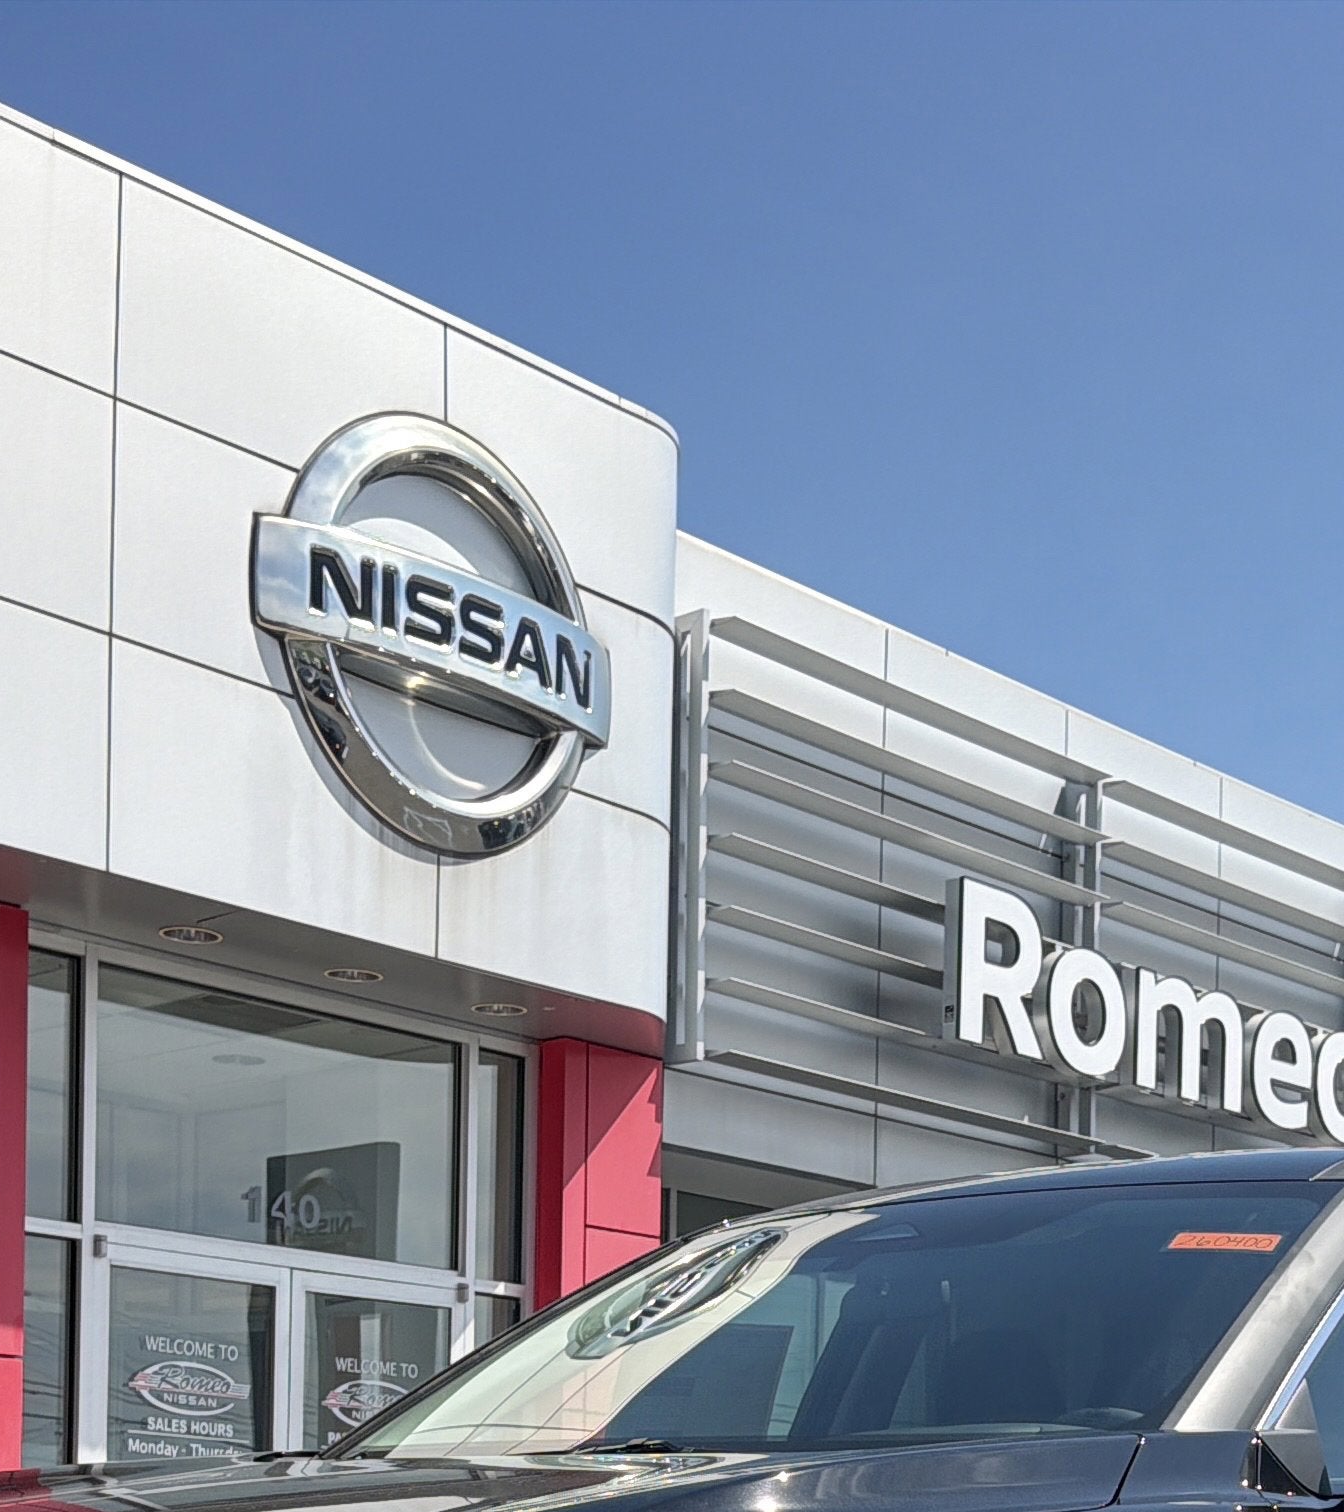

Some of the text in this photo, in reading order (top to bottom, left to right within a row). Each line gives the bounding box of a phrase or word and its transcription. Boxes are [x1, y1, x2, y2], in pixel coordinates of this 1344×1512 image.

[307, 542, 595, 714] NISSAN
[240, 1185, 321, 1234] 140
[145, 1335, 239, 1362] WELCOME TO
[157, 1364, 232, 1394] Romeo
[336, 1357, 419, 1379] WELCOME TO
[163, 1393, 218, 1408] NISSAN
[147, 1417, 234, 1437] SALES HOURS
[127, 1438, 180, 1458] Monday
